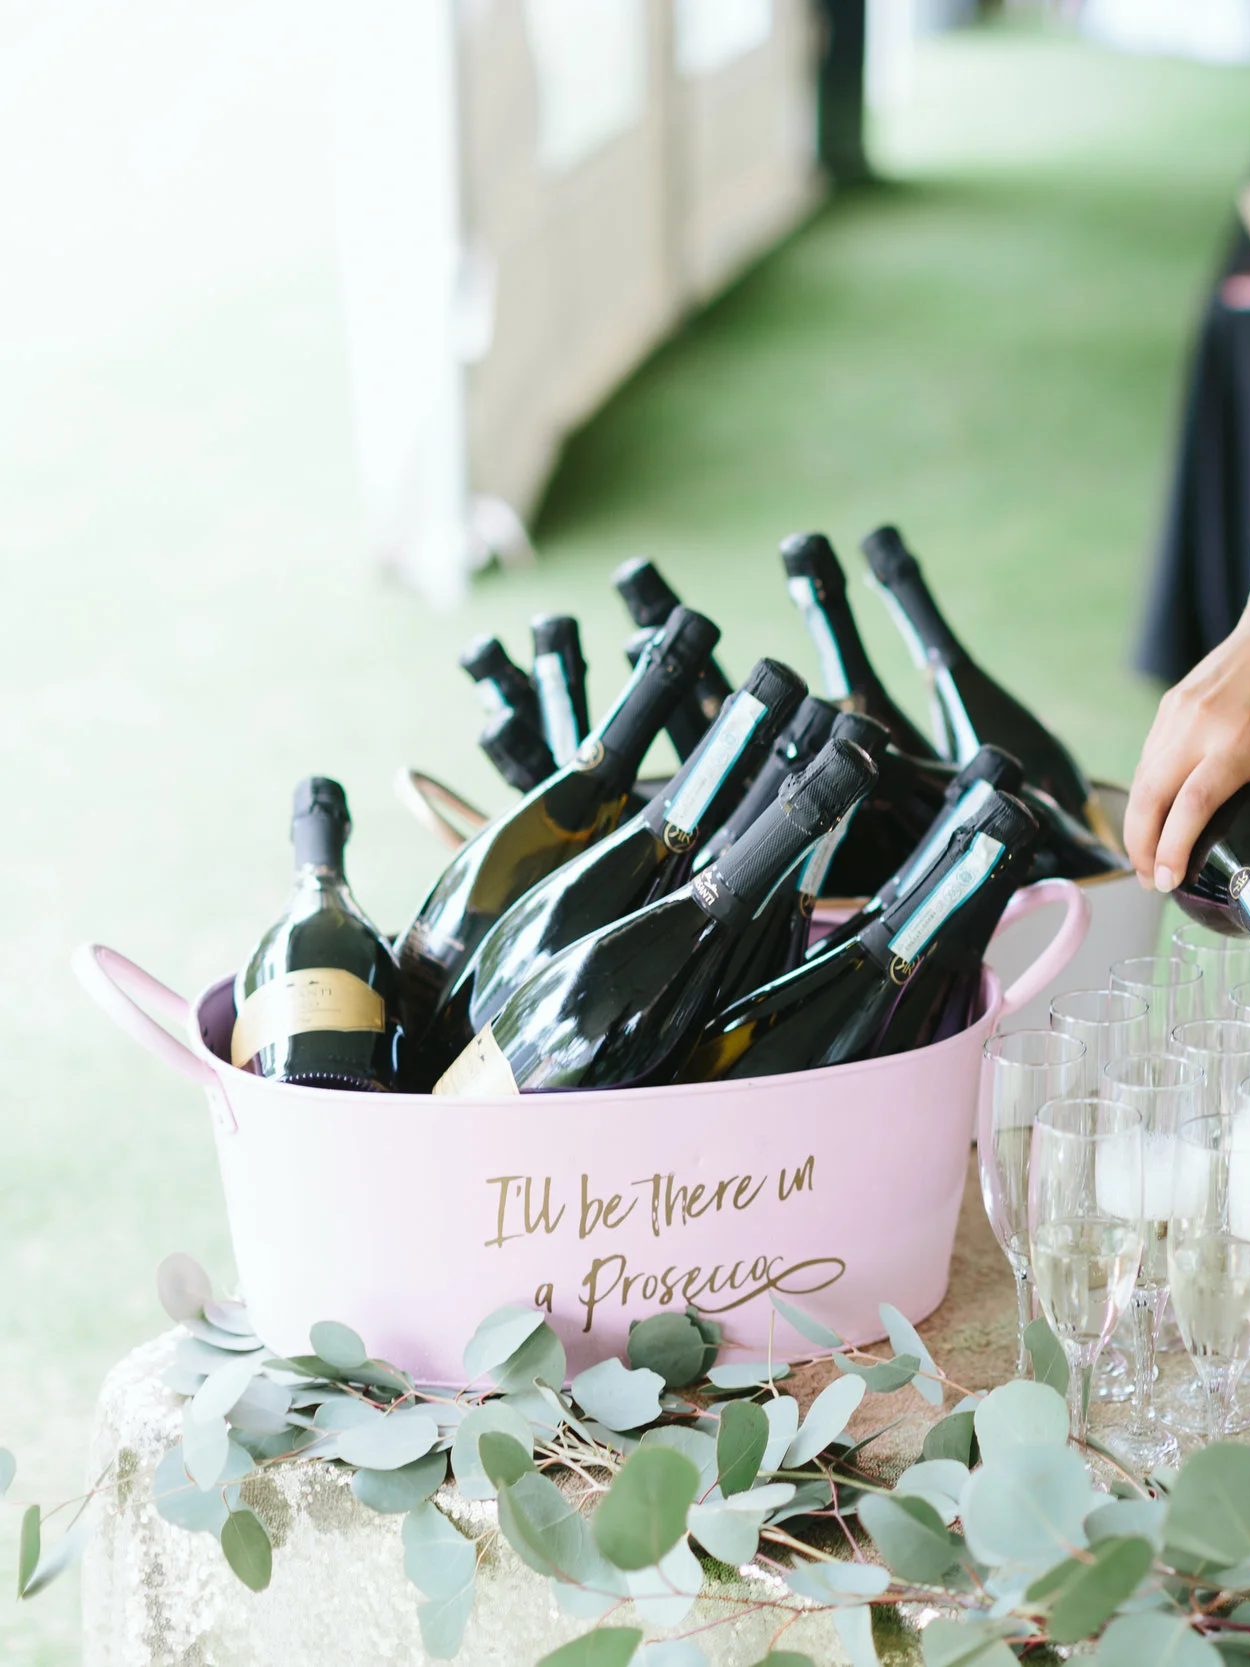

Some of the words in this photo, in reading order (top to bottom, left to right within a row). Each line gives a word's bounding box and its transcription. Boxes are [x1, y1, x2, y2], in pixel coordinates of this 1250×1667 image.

[484, 1173, 567, 1249] I'll
[578, 1172, 640, 1240] be
[777, 1154, 816, 1202] in
[534, 1279, 554, 1313] a
[578, 1253, 847, 1333] Prosecco
